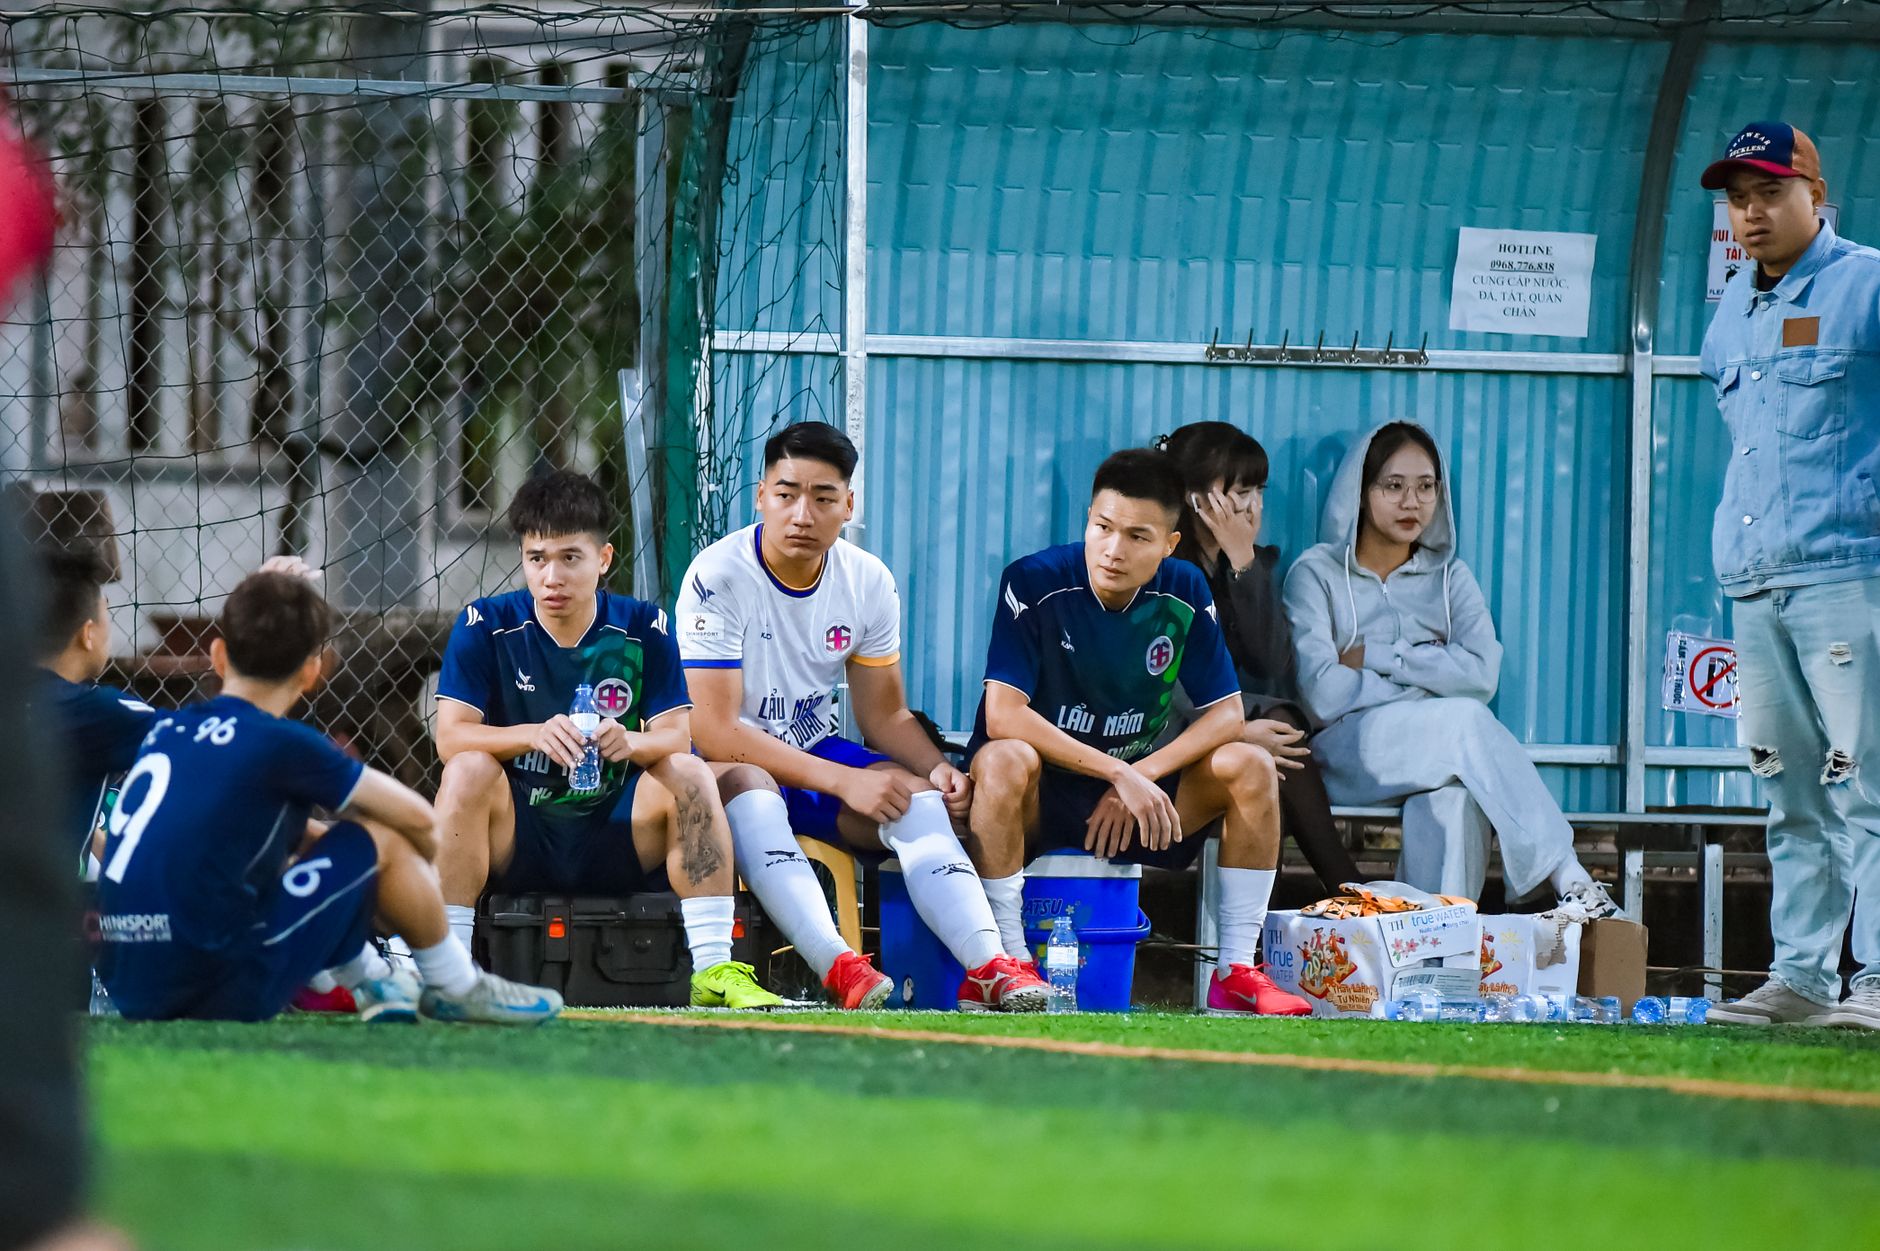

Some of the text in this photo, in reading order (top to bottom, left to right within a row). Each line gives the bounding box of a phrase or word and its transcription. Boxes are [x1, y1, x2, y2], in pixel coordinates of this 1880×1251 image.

[1498, 243, 1553, 256] HOTLINE
[1725, 245, 1742, 261] TÀI
[1472, 275, 1504, 287] CUNG
[1057, 702, 1145, 737] LẨU NẤM
[105, 752, 171, 885] 9
[1388, 907, 1467, 931] TH true WATER
[1268, 929, 1283, 945] TH
[1268, 945, 1294, 968] true
